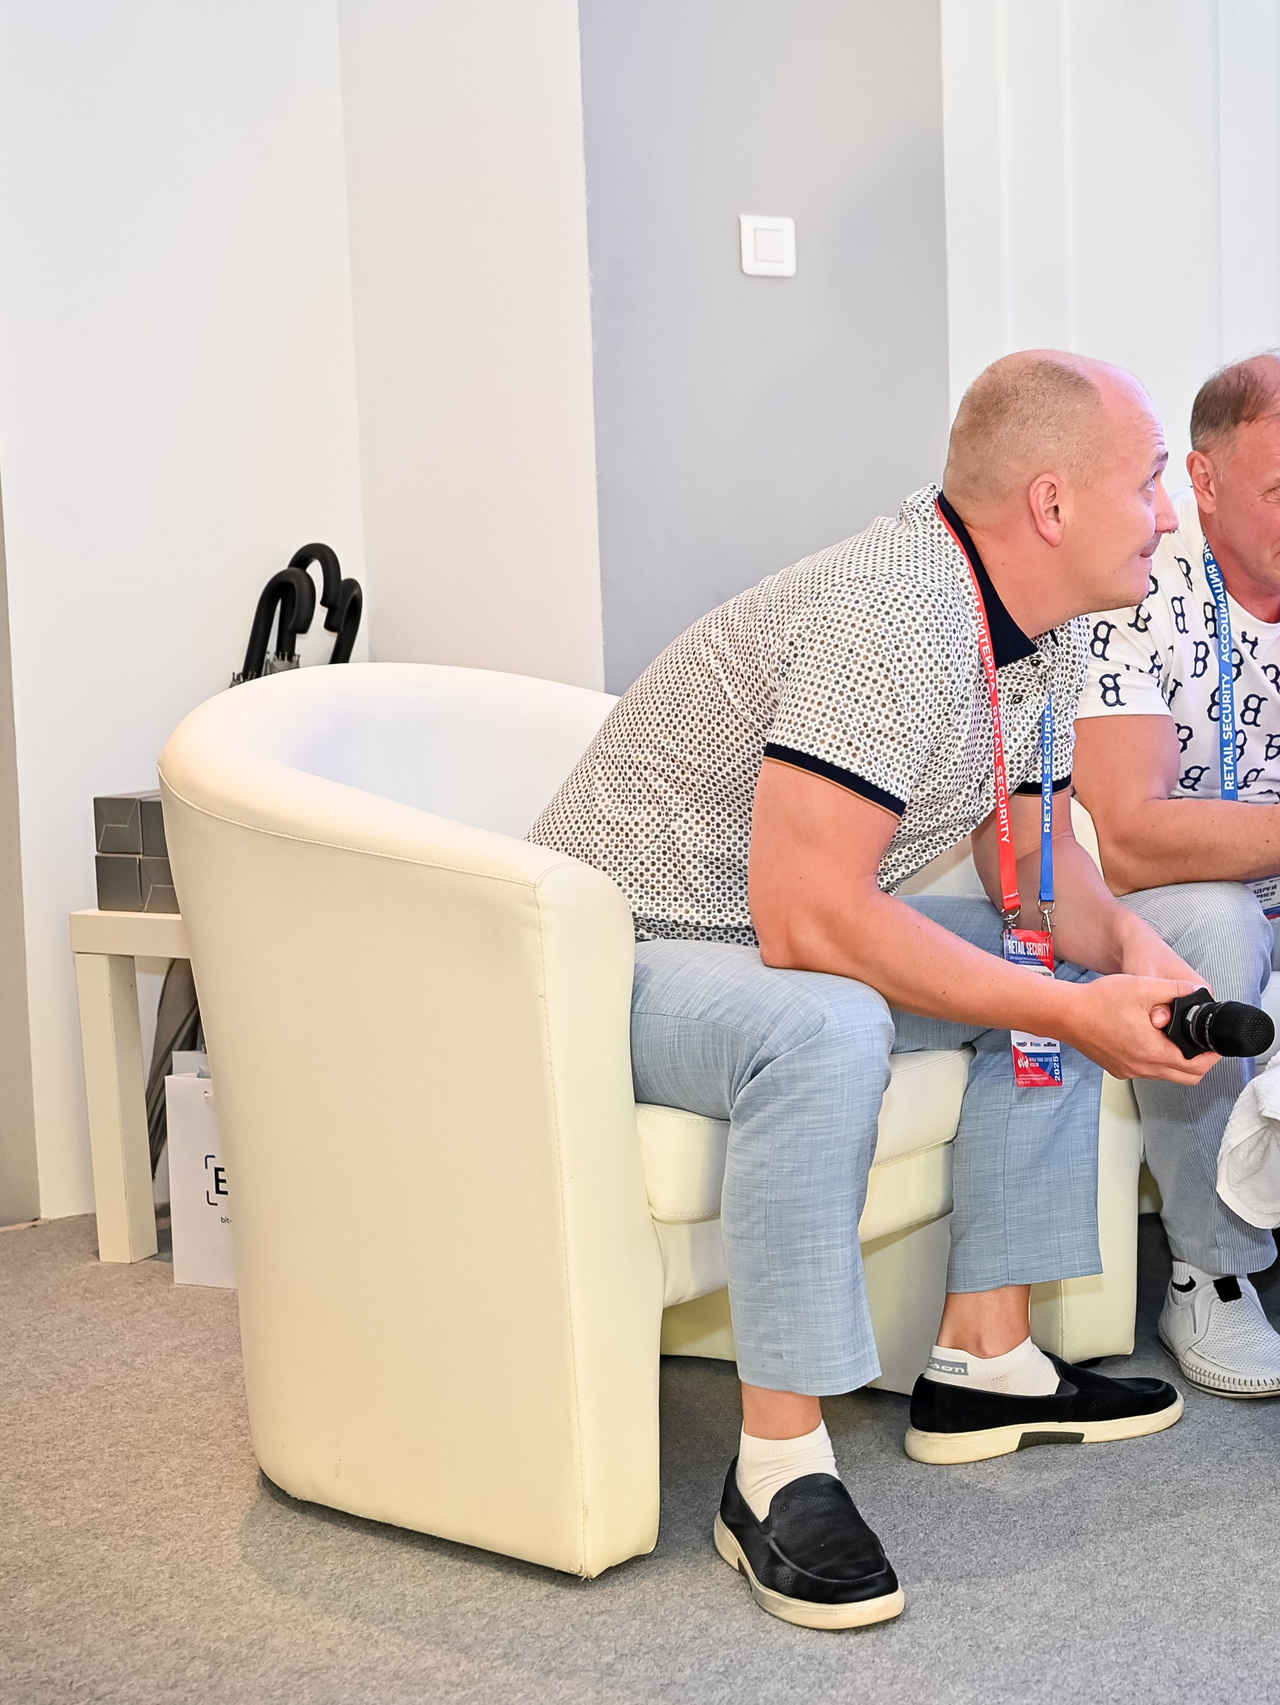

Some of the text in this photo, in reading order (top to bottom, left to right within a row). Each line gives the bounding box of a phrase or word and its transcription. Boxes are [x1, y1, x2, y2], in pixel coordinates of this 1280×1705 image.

[1206, 564, 1230, 663] АССОЦИАЦИЯ
[1222, 673, 1235, 790] RETAIL SECURITY
[996, 765, 1010, 843] SECURITY
[1043, 776, 1052, 833] RETAIL
[1007, 940, 1050, 957] RETAIL SECURITY
[1053, 1055, 1061, 1082] 2025
